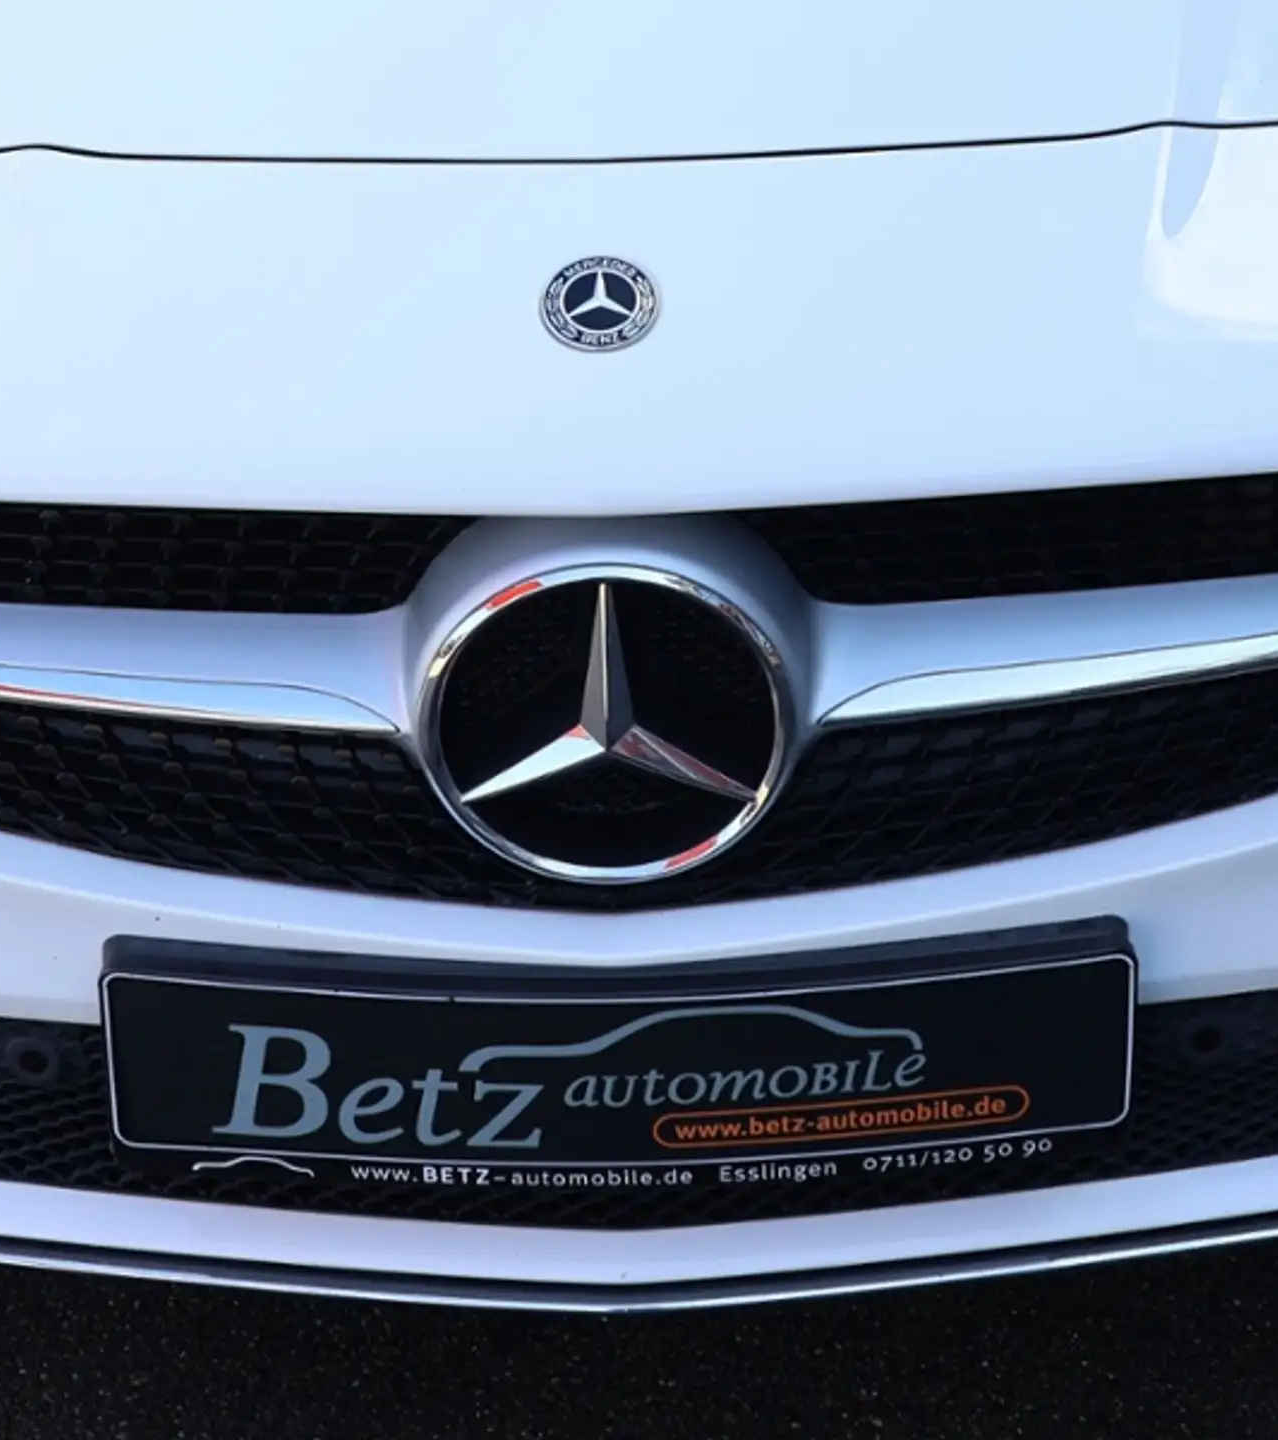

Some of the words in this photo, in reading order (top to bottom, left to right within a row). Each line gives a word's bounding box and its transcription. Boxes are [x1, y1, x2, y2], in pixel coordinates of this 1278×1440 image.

[212, 1023, 545, 1148] Betz
[674, 1095, 1008, 1140] www.betz-automobile.de
[350, 1165, 694, 1188] www.BETZ-automobile.de
[719, 1161, 838, 1183] Esslingen
[862, 1147, 974, 1173] 0711/120
[984, 1142, 1013, 1164] 50
[1022, 1137, 1053, 1158] 90
